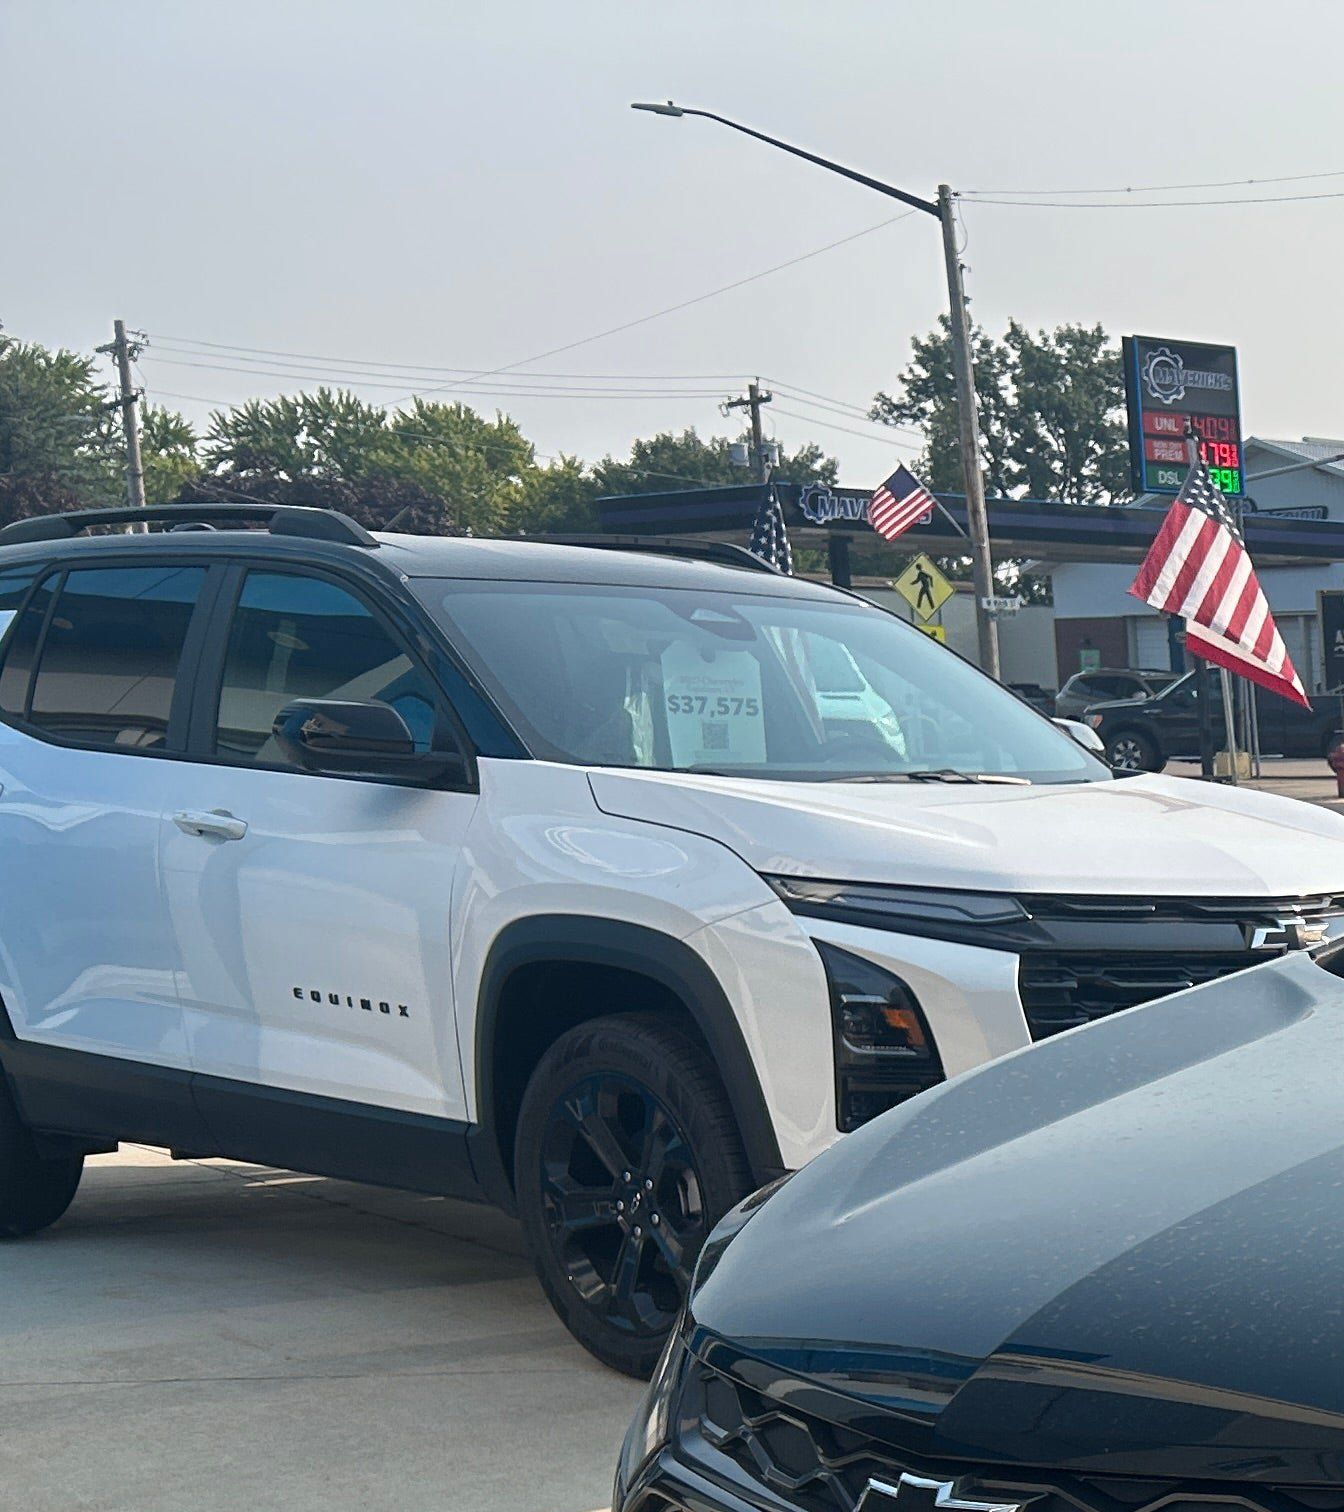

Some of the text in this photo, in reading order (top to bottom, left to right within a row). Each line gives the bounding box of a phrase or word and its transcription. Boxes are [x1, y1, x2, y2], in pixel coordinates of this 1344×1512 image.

[1154, 416, 1179, 432] UNL
[1158, 470, 1183, 485] DSL
[667, 694, 760, 718] $37,575
[292, 987, 409, 1018] EQUINOX
